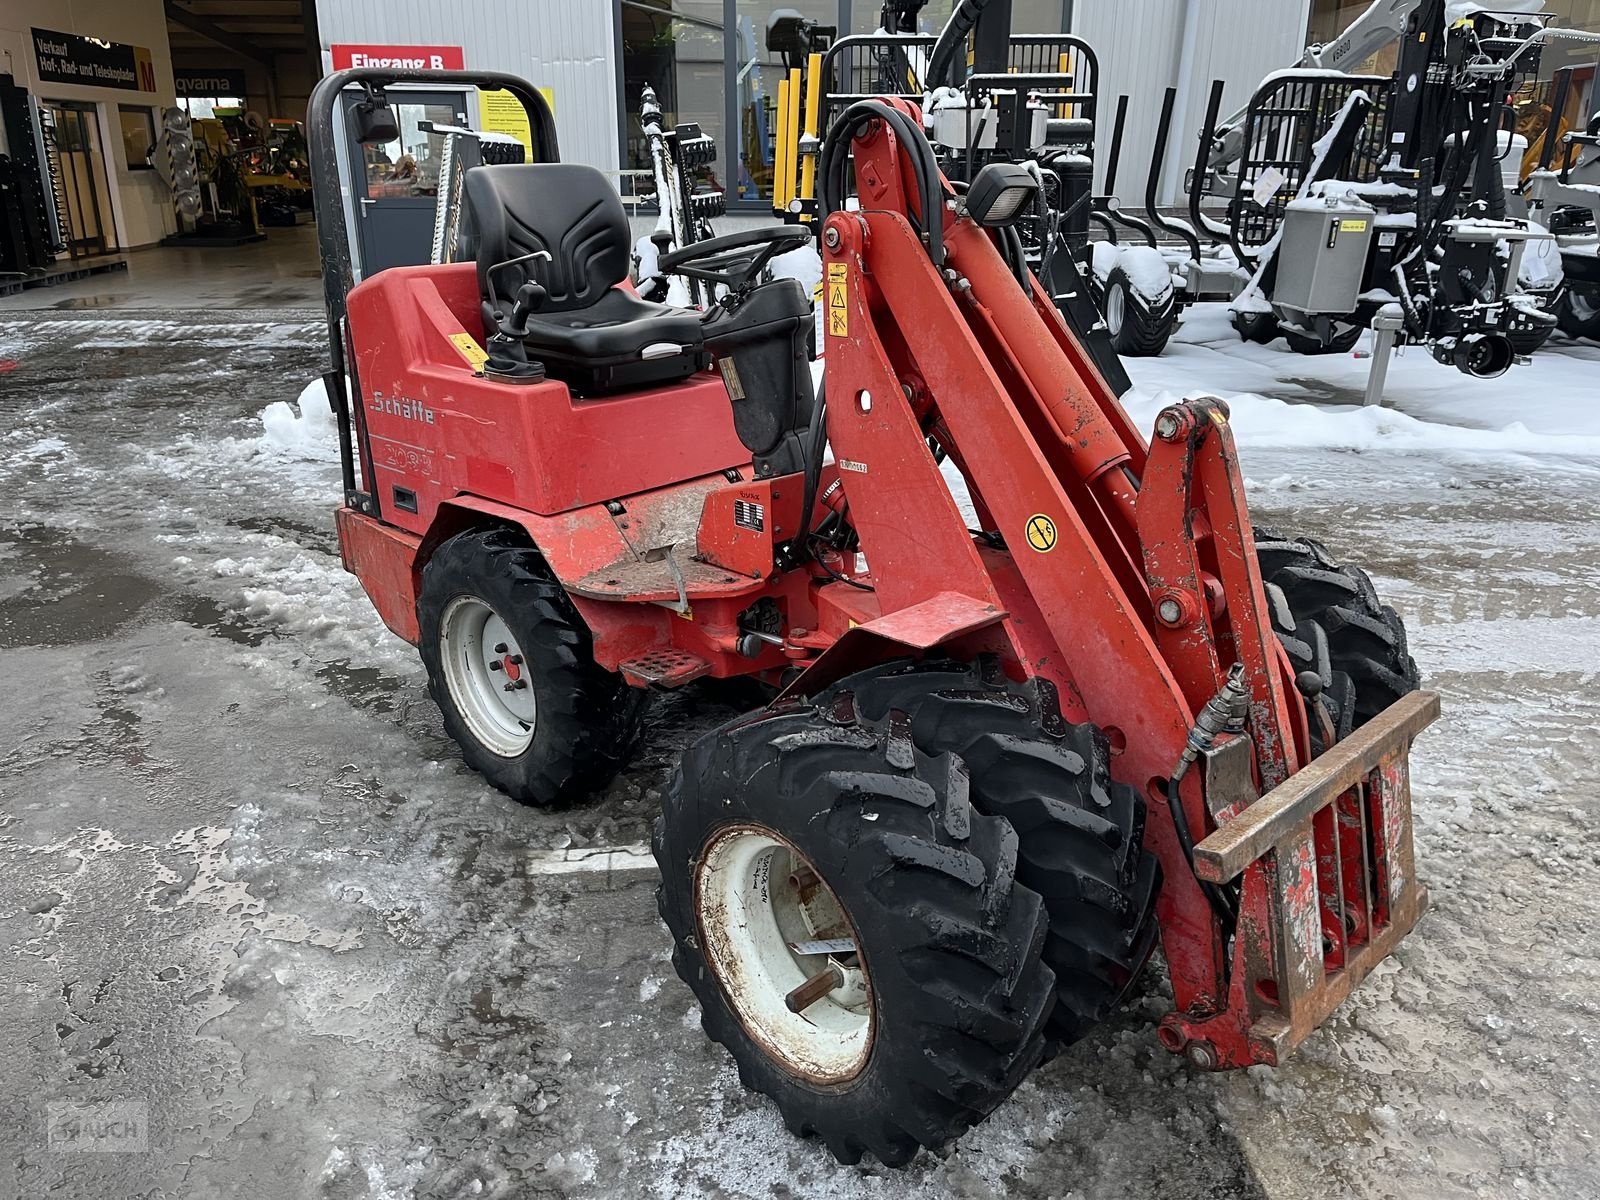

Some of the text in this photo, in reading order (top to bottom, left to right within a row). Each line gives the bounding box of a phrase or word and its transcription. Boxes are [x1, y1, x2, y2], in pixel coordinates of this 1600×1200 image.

[37, 38, 68, 56] Verkauf
[39, 56, 135, 82] Hof-, Rad- und Teleskoplader
[351, 54, 444, 70] Eingang B
[176, 78, 230, 93] qvarna
